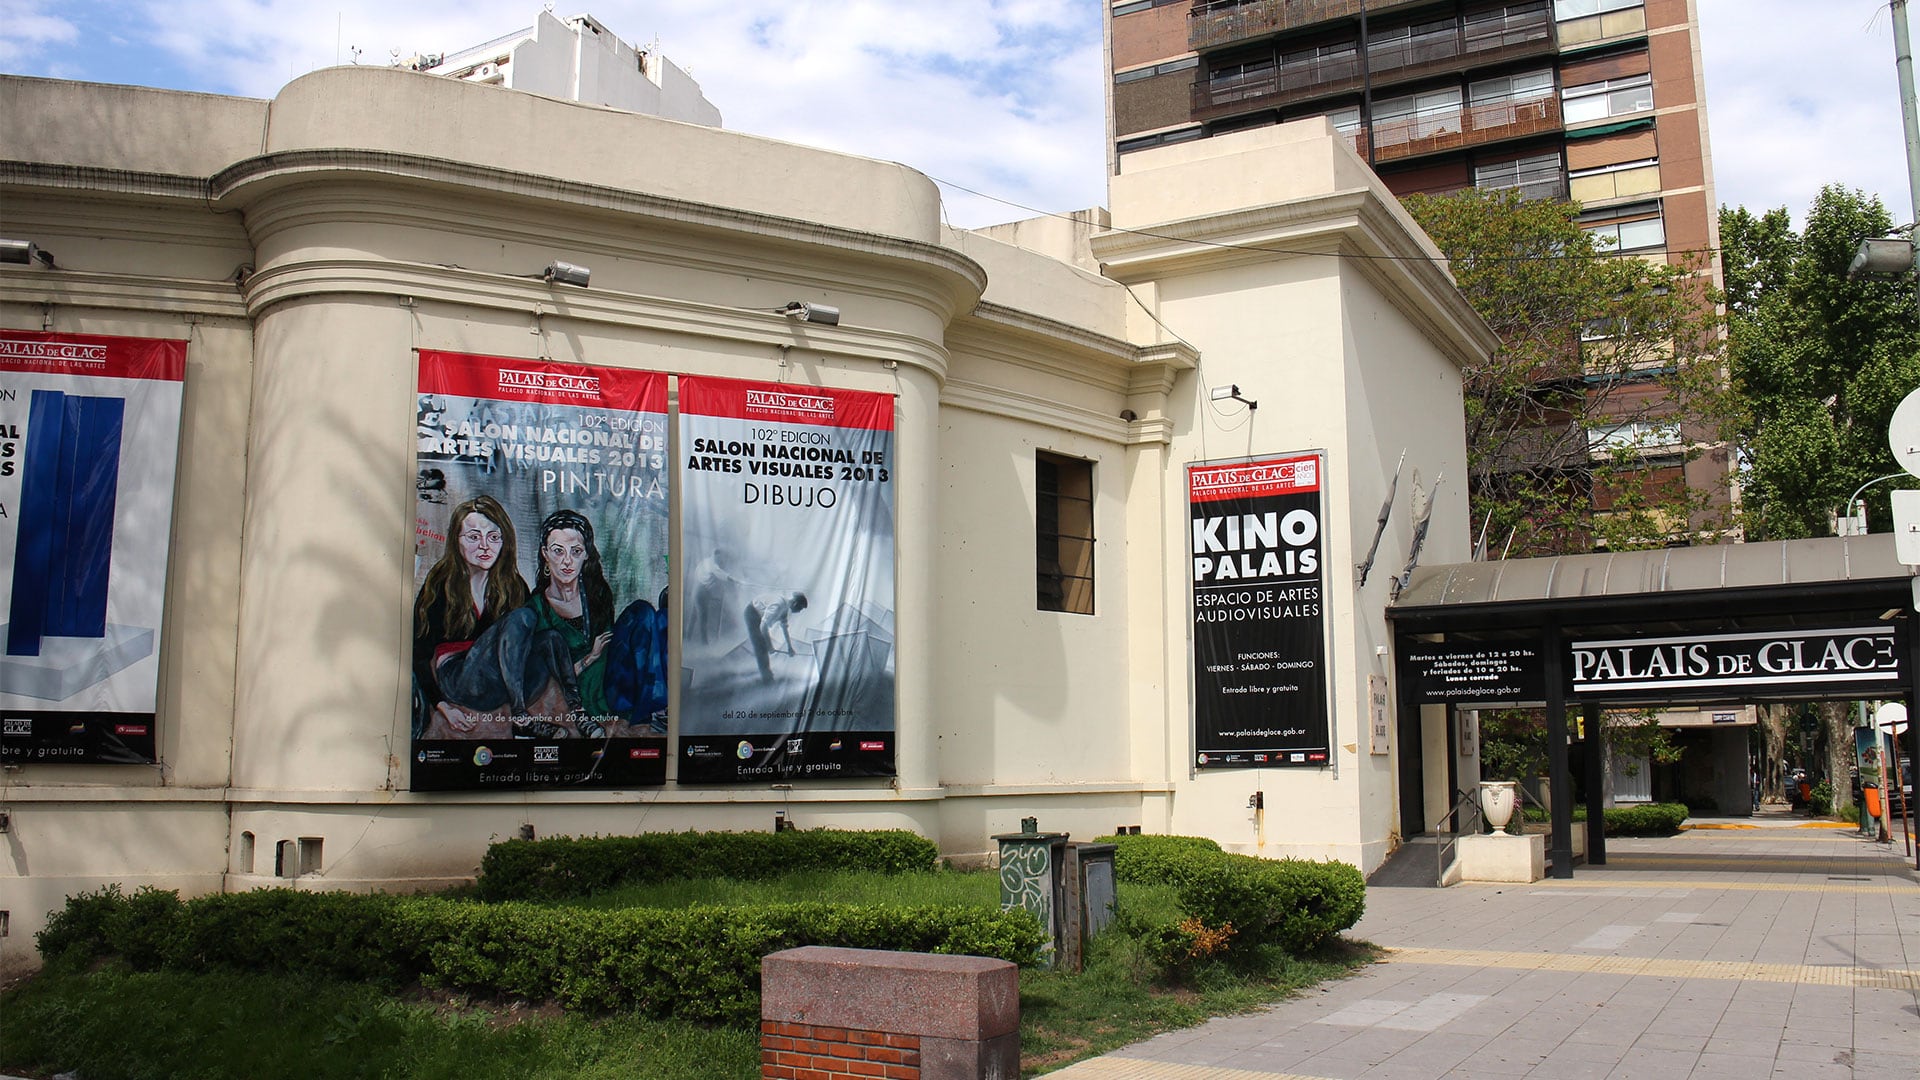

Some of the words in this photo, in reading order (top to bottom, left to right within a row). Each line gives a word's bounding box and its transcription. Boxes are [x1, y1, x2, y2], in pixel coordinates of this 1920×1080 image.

[47, 348, 59, 357] DE
[60, 346, 107, 360] GLACE
[499, 372, 544, 386] PALAIS
[559, 377, 600, 391] GLACE
[526, 388, 555, 397] NACIONAL
[746, 393, 786, 407] PALAIS
[799, 398, 834, 411] GLACE
[771, 409, 796, 417] NACIONAL
[611, 418, 664, 433] EDICION
[446, 421, 517, 442] SALON
[527, 426, 633, 448] NACIONAL
[640, 434, 664, 450] DE
[781, 431, 831, 445] EDICION
[427, 437, 494, 458] ARTES
[501, 443, 601, 464] VISUALES
[608, 450, 664, 469] 2013
[694, 438, 755, 457] SALON
[763, 444, 856, 464] NACIONAL
[862, 451, 883, 465] DE
[687, 455, 742, 474] ARTES
[748, 460, 834, 480] VISUALES
[840, 468, 889, 483] 2013
[1193, 471, 1238, 487] PALAIS
[1239, 474, 1251, 482] DE
[1252, 466, 1295, 481] GLACE
[543, 470, 665, 500] PINTURA
[1192, 489, 1217, 497] PALACIO
[1219, 486, 1249, 495] NACIONAL
[1276, 481, 1296, 489] ARTES
[744, 482, 837, 509] DIBUJO
[1193, 509, 1318, 554] KINO
[1194, 549, 1318, 582] PALAIS
[1196, 591, 1251, 607] ESPACIO
[1256, 590, 1273, 603] DE
[1278, 587, 1319, 602] ARTES
[1196, 603, 1319, 623] AUDIOVISUALES
[1237, 652, 1281, 661] FUNCIONES:
[1476, 651, 1486, 659] de
[1523, 649, 1535, 657] hs.
[1571, 643, 1710, 682] PALAIS
[1716, 654, 1753, 675] DE
[1757, 636, 1899, 674] GLACE
[1206, 664, 1235, 673] VIERNES
[1241, 662, 1271, 671] SÁBADO
[1276, 660, 1314, 670] DOMINGO
[1430, 668, 1461, 676] feriados
[1510, 664, 1522, 672] hs.
[1470, 659, 1507, 667] domingos
[1469, 673, 1499, 681] cerrado
[1222, 686, 1247, 694] Entrada
[1249, 685, 1265, 693] libre
[1272, 684, 1299, 694] gratuita
[1425, 685, 1521, 697] www.palaisdeglace.gob.ar
[466, 713, 479, 721] del
[482, 714, 493, 722] 20
[495, 713, 506, 721] de
[508, 714, 553, 723] septiembre
[555, 713, 563, 721] al
[565, 713, 577, 721] 20
[579, 713, 589, 721] de
[591, 713, 619, 721] octubre
[722, 711, 734, 719] del
[736, 711, 746, 719] 20
[748, 710, 758, 719] de
[816, 708, 826, 717] de
[1218, 727, 1306, 738] www.palaisdeglace.gob.ar
[26, 748, 33, 758] y
[38, 747, 84, 758] gratuita
[737, 766, 773, 775] Entrada
[796, 765, 802, 773] y
[805, 762, 841, 773] gratuita
[480, 773, 520, 783] Entrada
[525, 772, 549, 782] libre
